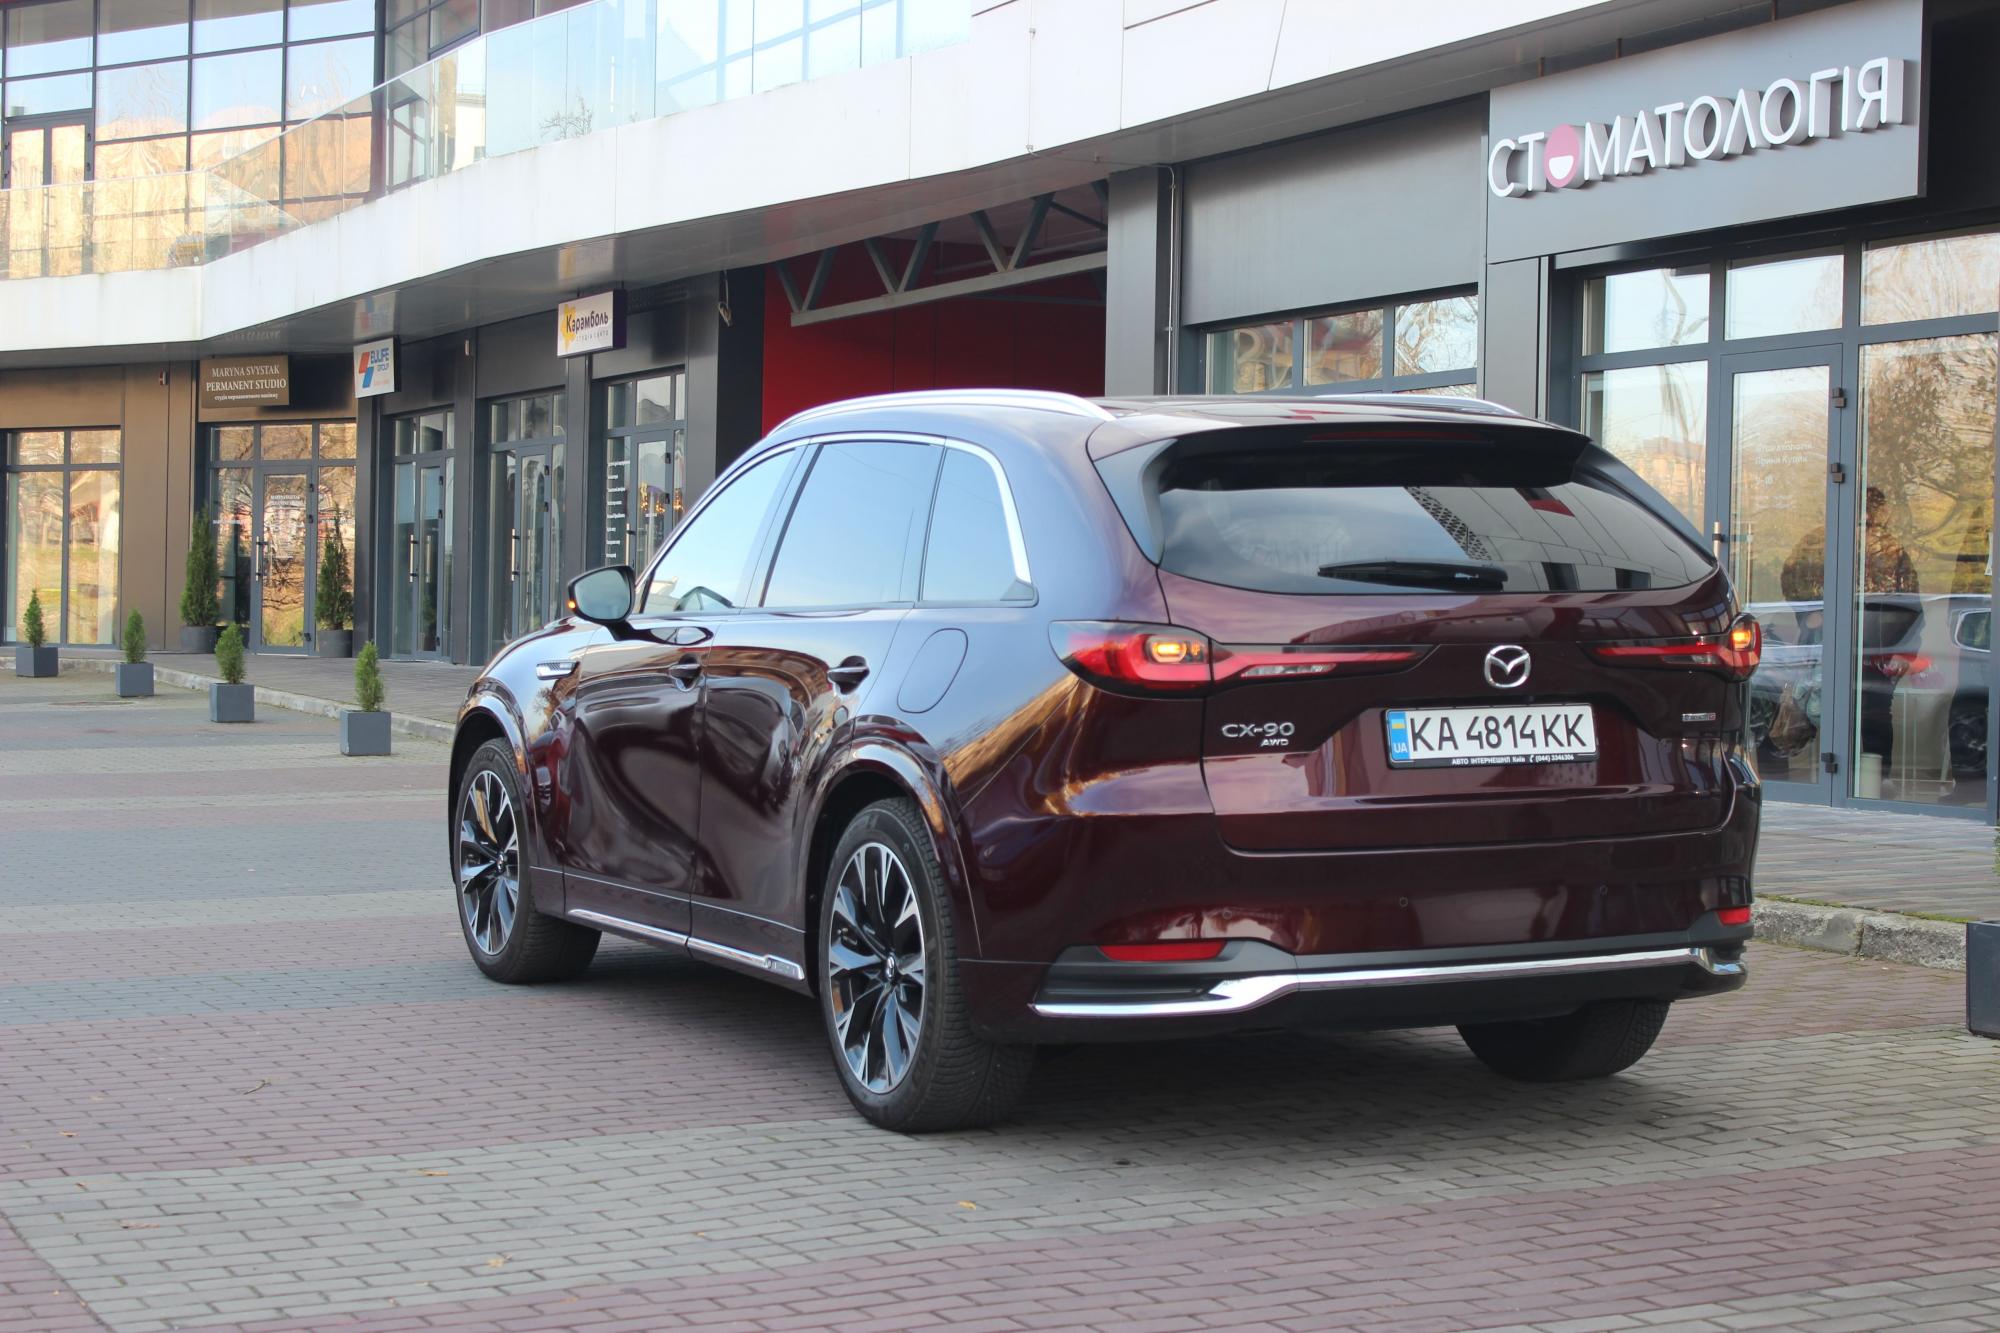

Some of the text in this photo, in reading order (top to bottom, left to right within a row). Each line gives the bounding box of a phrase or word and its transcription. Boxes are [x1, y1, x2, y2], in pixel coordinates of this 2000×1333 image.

[488, 57, 1894, 198] СТОМАТОЛОГІЯ
[566, 310, 609, 334] Карамболь
[212, 365, 280, 377] MARYNA SVYSTAK
[206, 378, 287, 392] PERMANENT STUDIO
[1221, 722, 1295, 738] CX-90
[1409, 713, 1587, 752] KA 4814 KK
[1260, 738, 1289, 747] AWD
[1393, 741, 1408, 754] UA
